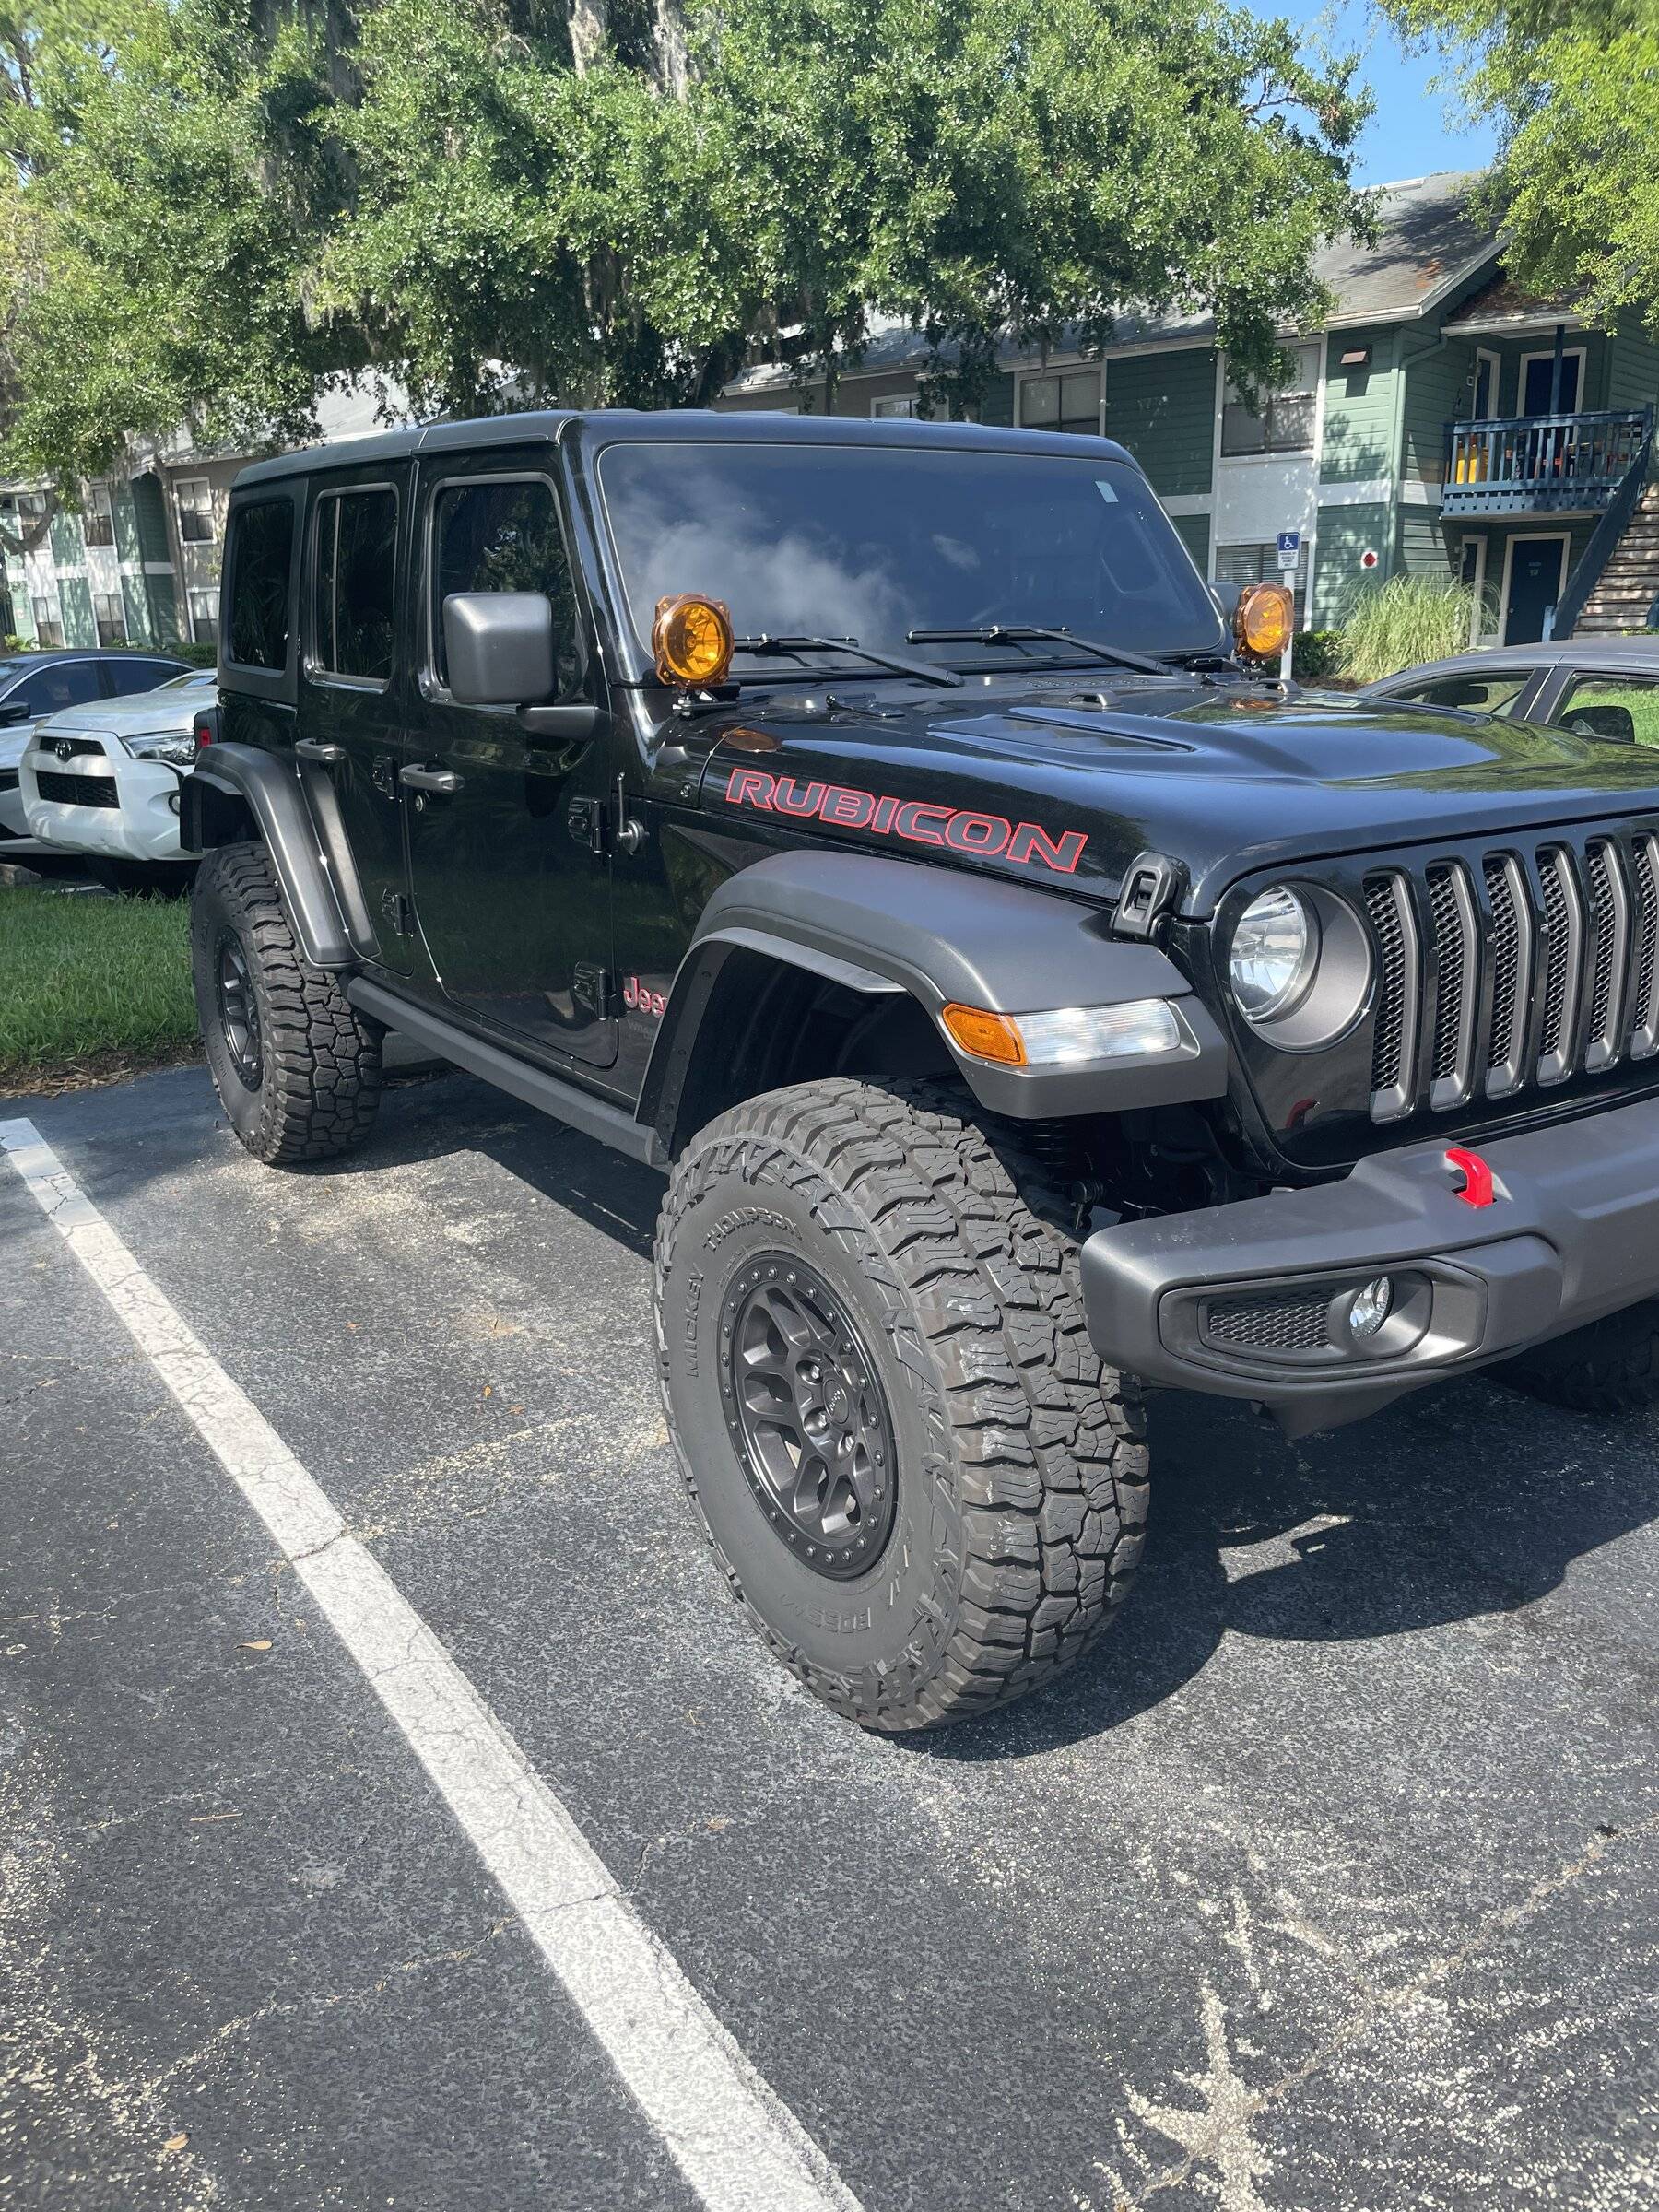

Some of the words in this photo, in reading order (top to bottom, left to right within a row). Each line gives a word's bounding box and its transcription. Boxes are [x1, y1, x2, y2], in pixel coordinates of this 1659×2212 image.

[725, 768, 1088, 873] RUBICON
[623, 977, 667, 1018] Jee
[685, 1262, 704, 1378] MICKEY
[702, 1206, 803, 1252] THOMPSON
